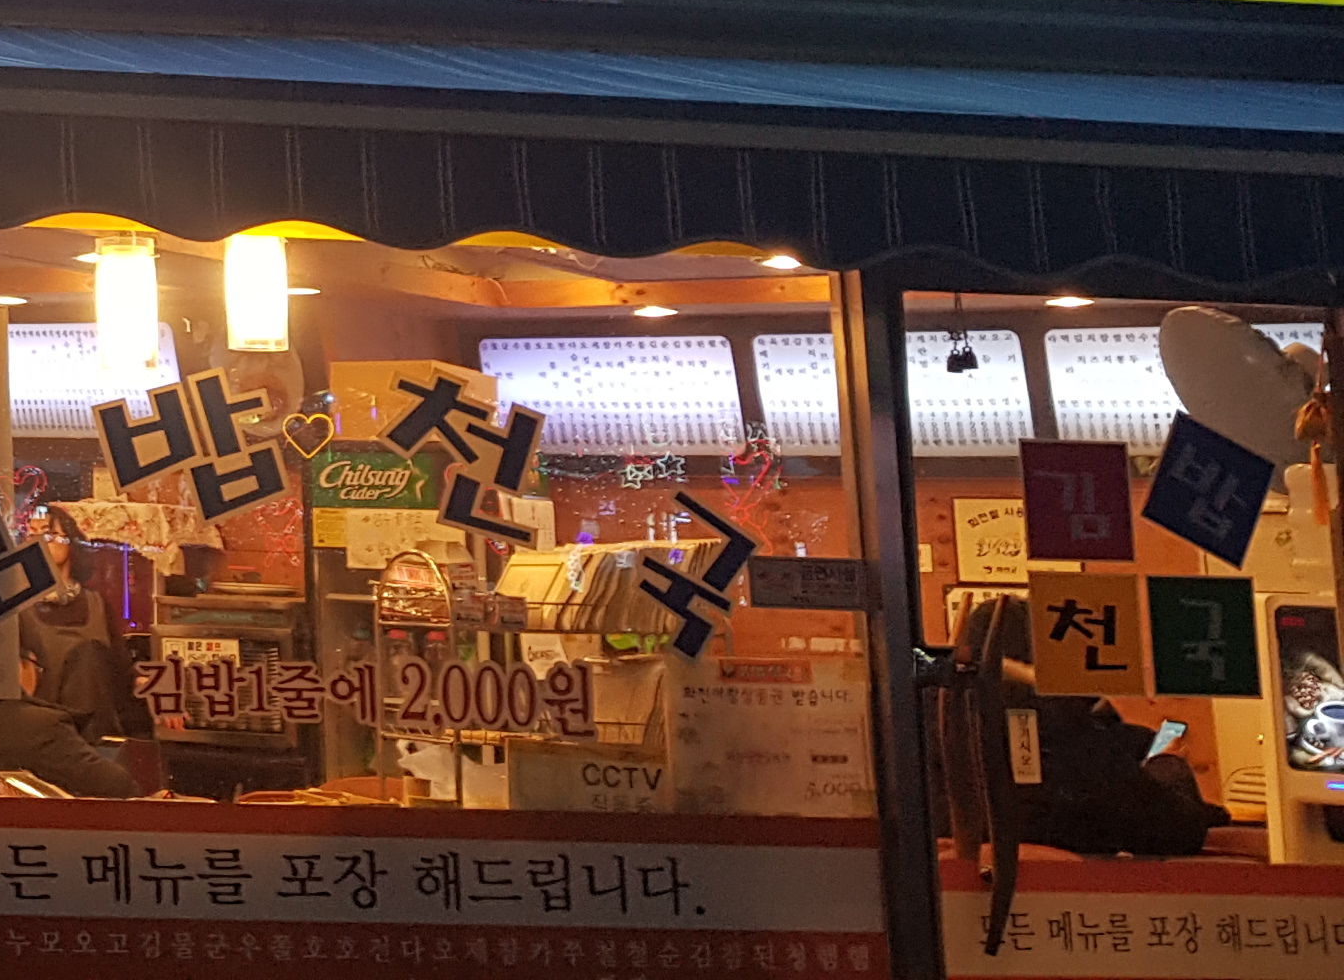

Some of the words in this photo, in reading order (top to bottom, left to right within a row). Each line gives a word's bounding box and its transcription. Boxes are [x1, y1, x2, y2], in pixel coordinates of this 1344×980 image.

[318, 459, 412, 496] Chilsung
[339, 486, 391, 501] Cider
[1031, 466, 1111, 543] 김
[1046, 597, 1128, 672] 천
[133, 657, 378, 723] 김밥1줄에
[398, 657, 598, 741] 2,000원
[582, 762, 663, 791] CCTV
[82, 842, 253, 906] 메뉴를
[276, 848, 389, 911] 포장
[414, 850, 706, 917] 해드립니다.
[1047, 910, 1134, 953] 메뉴를
[1146, 911, 1203, 955] 포장
